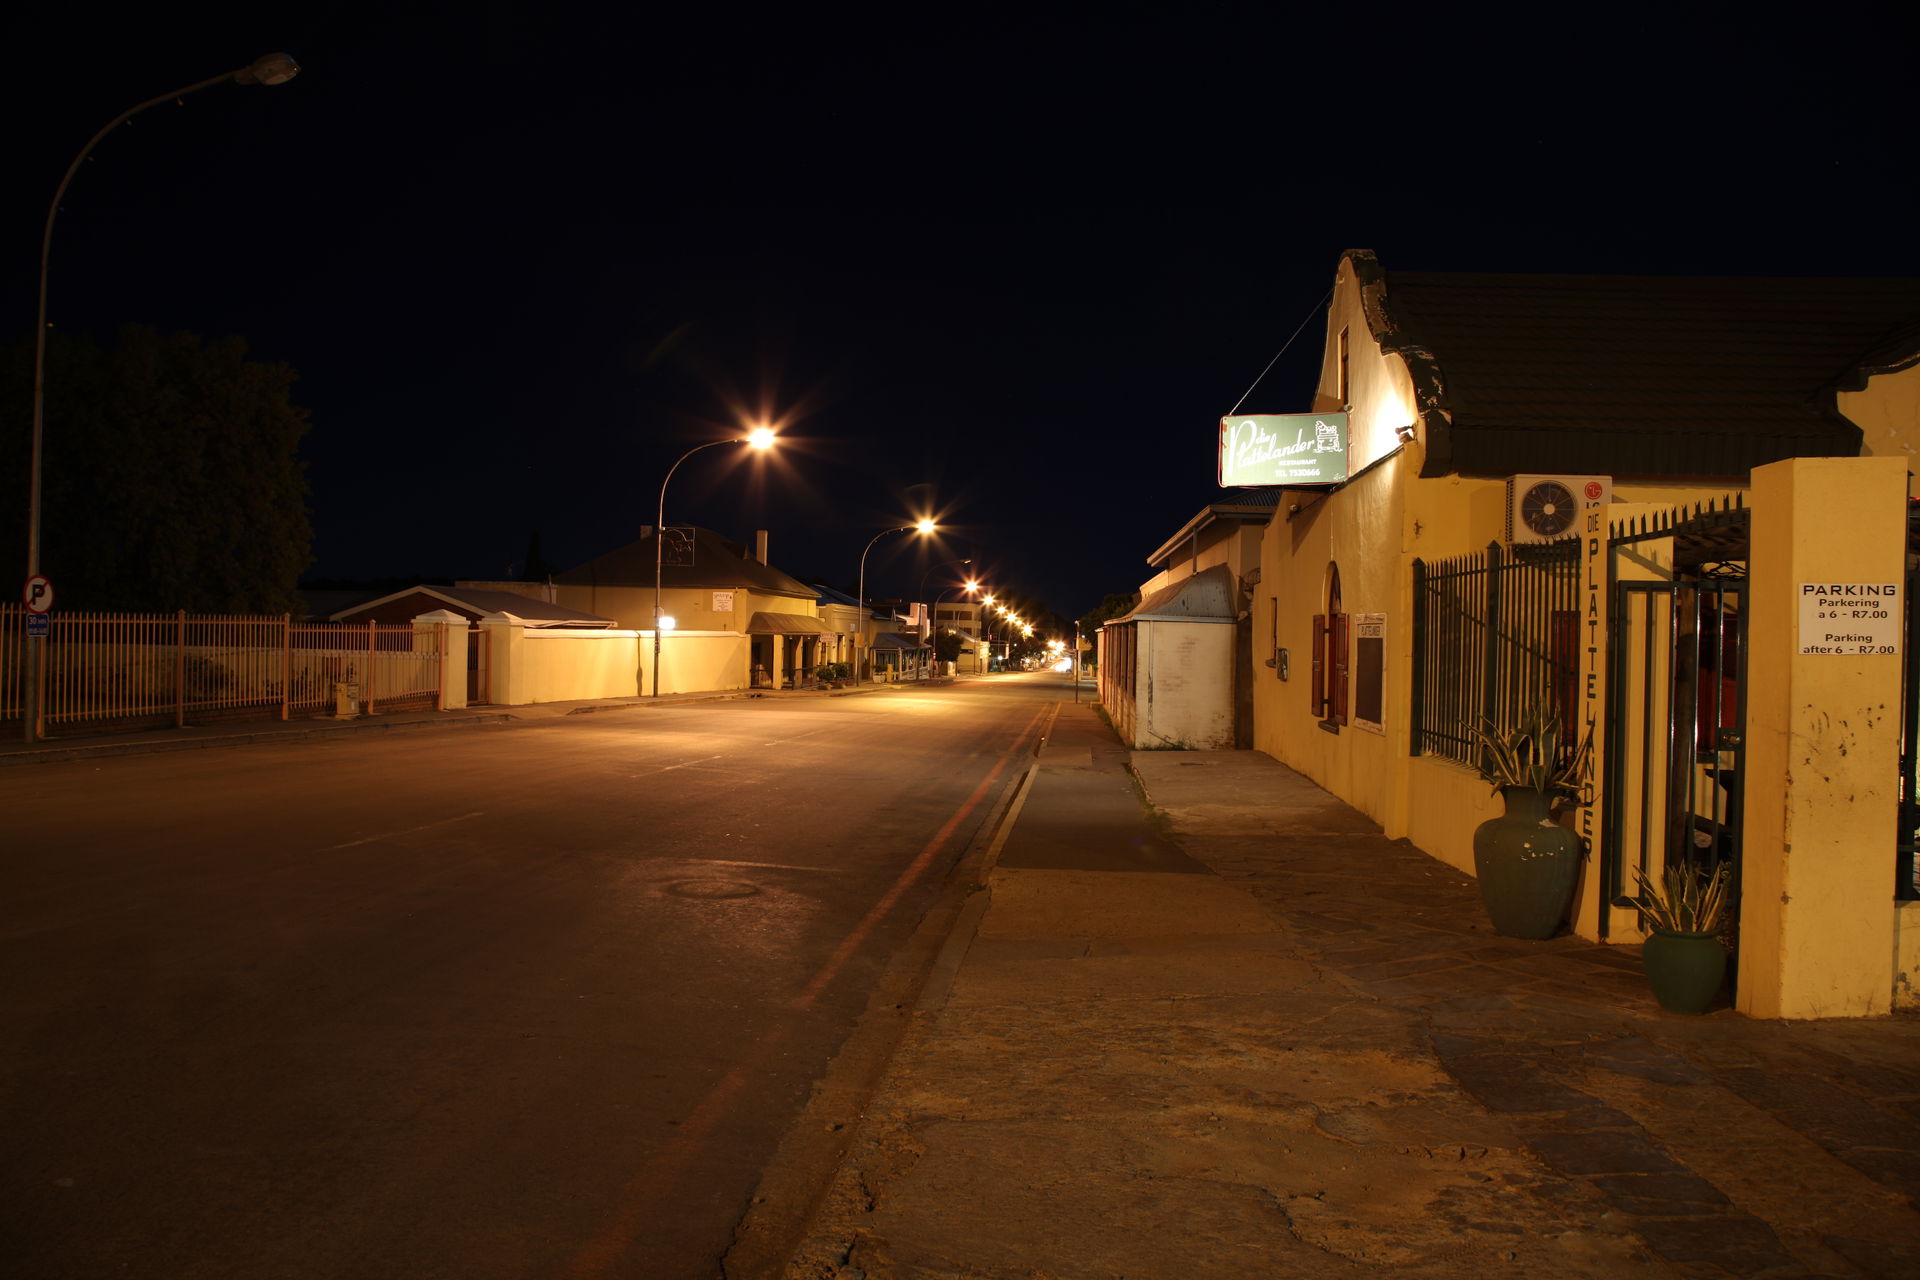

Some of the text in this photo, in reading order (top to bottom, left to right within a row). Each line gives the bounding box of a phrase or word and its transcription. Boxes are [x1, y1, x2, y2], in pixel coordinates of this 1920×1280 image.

[1587, 513, 1599, 533] DIE
[1803, 585, 1896, 596] PARKING
[1819, 599, 1880, 608] Parkering
[1825, 634, 1873, 643] Parking
[1803, 646, 1832, 654] after
[1835, 646, 1843, 654] 6
[1859, 646, 1895, 654] R7.00
